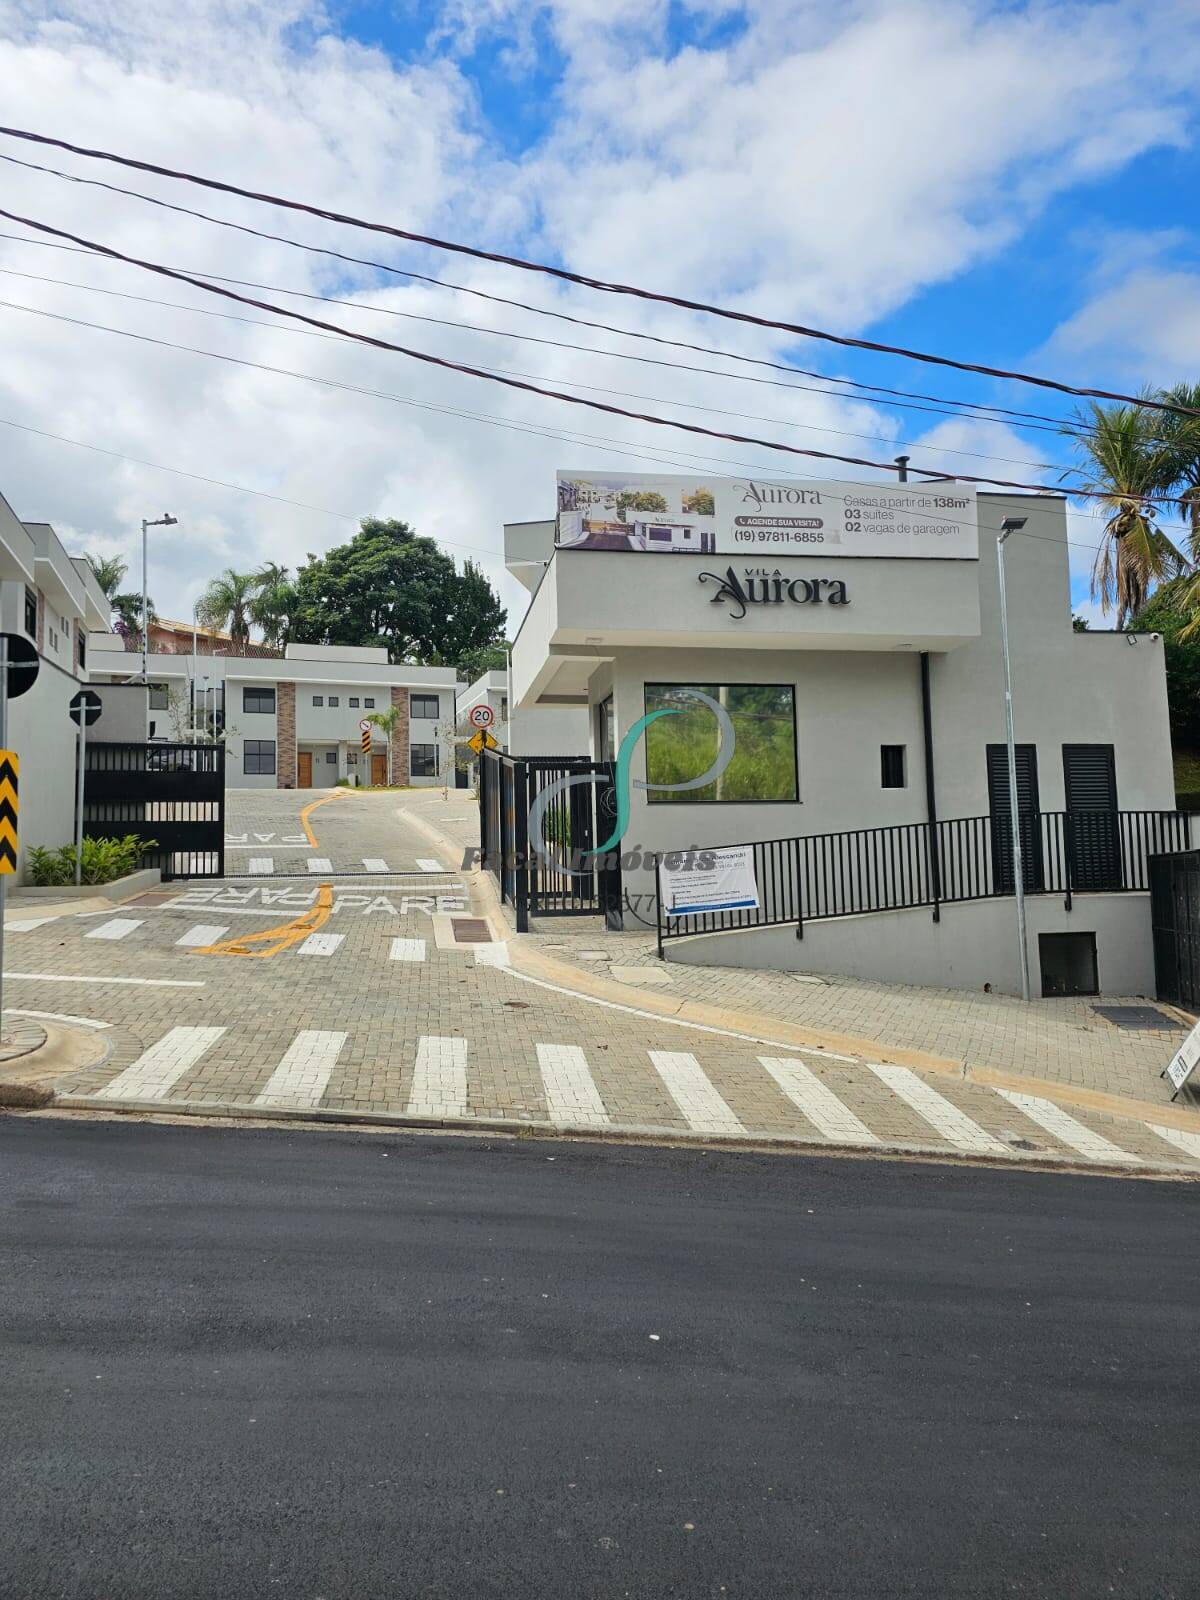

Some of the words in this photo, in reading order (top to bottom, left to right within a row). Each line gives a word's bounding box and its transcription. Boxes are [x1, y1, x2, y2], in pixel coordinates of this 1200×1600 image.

[732, 481, 822, 512] Aurora
[844, 495, 878, 507] Casas
[880, 498, 886, 507] a
[888, 497, 916, 510] partir
[917, 497, 931, 508] de
[844, 509, 861, 519] 03
[747, 517, 778, 526] AGENDE
[779, 518, 792, 526] SUA
[794, 518, 819, 527] VISITA!
[845, 522, 861, 532] 02
[863, 524, 895, 535] vagas
[897, 523, 910, 534] de
[913, 525, 960, 536] garagem
[735, 529, 755, 542] (19)
[758, 531, 824, 543] 97811-6855
[744, 568, 782, 577] VILA
[698, 565, 852, 619] Aurora
[474, 710, 490, 721] 20
[333, 895, 469, 916] PARE
